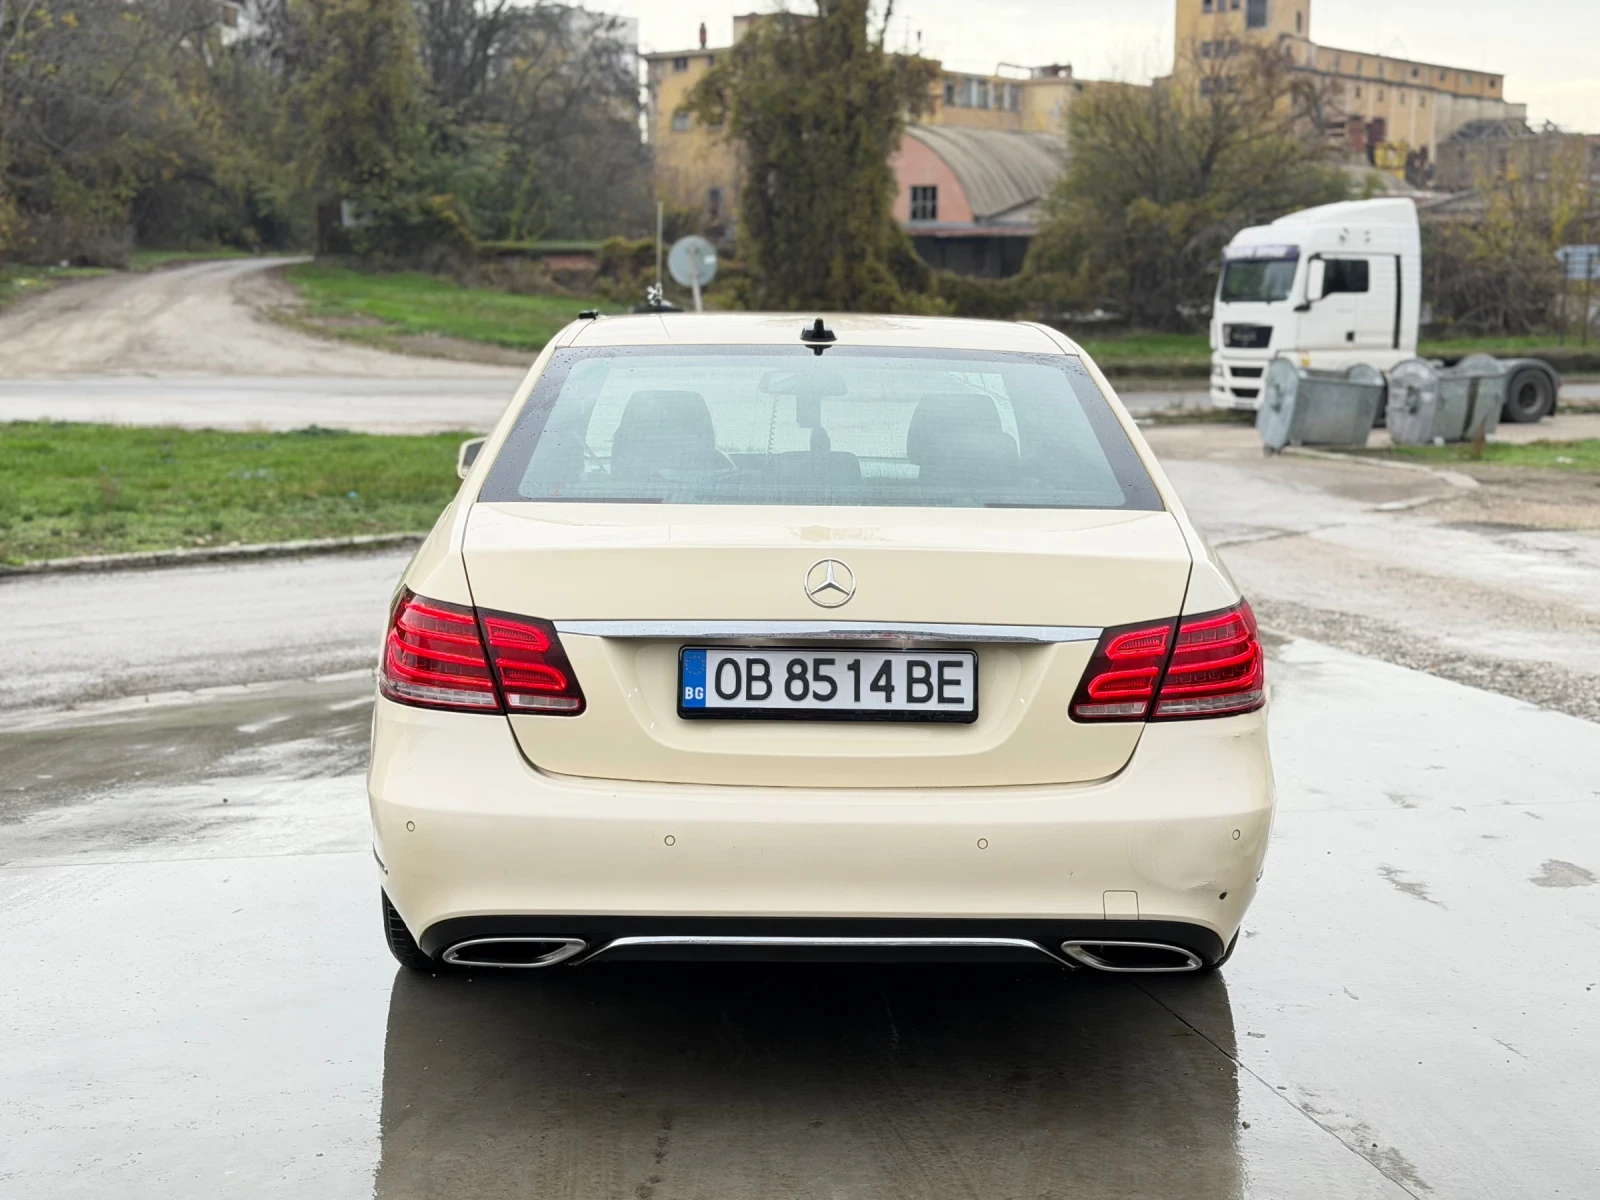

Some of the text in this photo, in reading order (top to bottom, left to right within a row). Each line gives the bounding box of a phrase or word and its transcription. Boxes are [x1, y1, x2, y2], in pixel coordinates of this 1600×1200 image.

[685, 686, 704, 700] BG
[714, 657, 965, 704] OB 8514 BE
